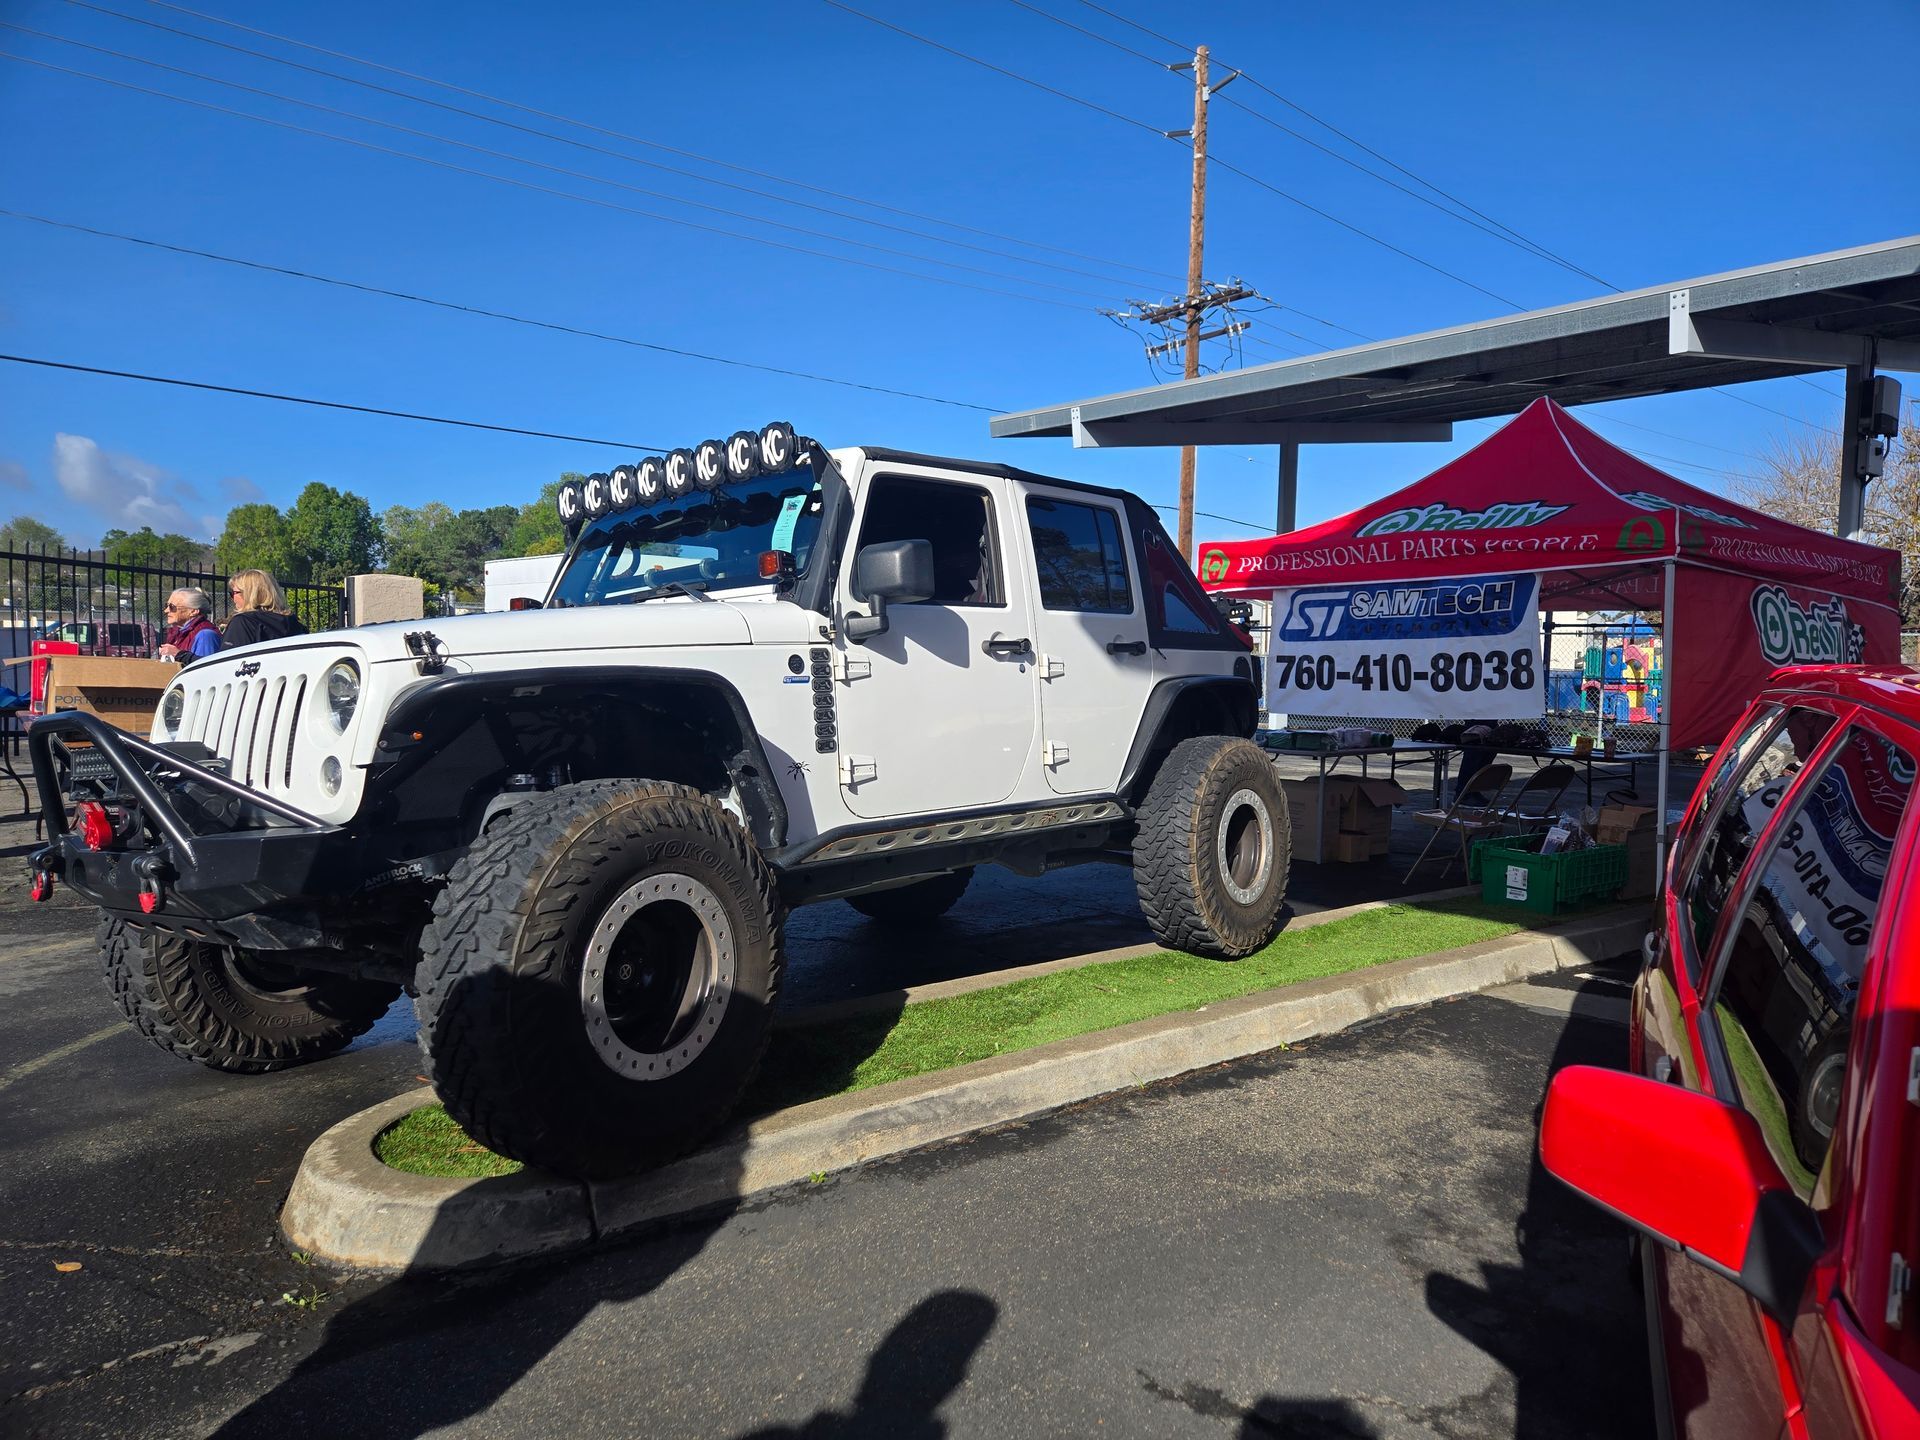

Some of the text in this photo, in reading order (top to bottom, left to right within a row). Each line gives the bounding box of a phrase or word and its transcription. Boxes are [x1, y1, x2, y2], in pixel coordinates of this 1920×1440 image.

[696, 445, 718, 481] KC
[728, 437, 750, 474] KC
[761, 429, 785, 466] KC
[610, 471, 629, 504] KC
[637, 463, 657, 497] KC
[665, 455, 686, 489] KC
[558, 486, 576, 518] KC
[584, 480, 602, 512] KC
[1236, 534, 1600, 573] PROFESSIONAL PARTS PEOPLE
[1709, 535, 1817, 568] PROFESSIONAL
[1350, 580, 1516, 618] SAMTECH
[1276, 648, 1535, 693] 760-410-8038
[644, 838, 762, 945] YOKOHAMA
[196, 944, 328, 1032] GEOLANDA
